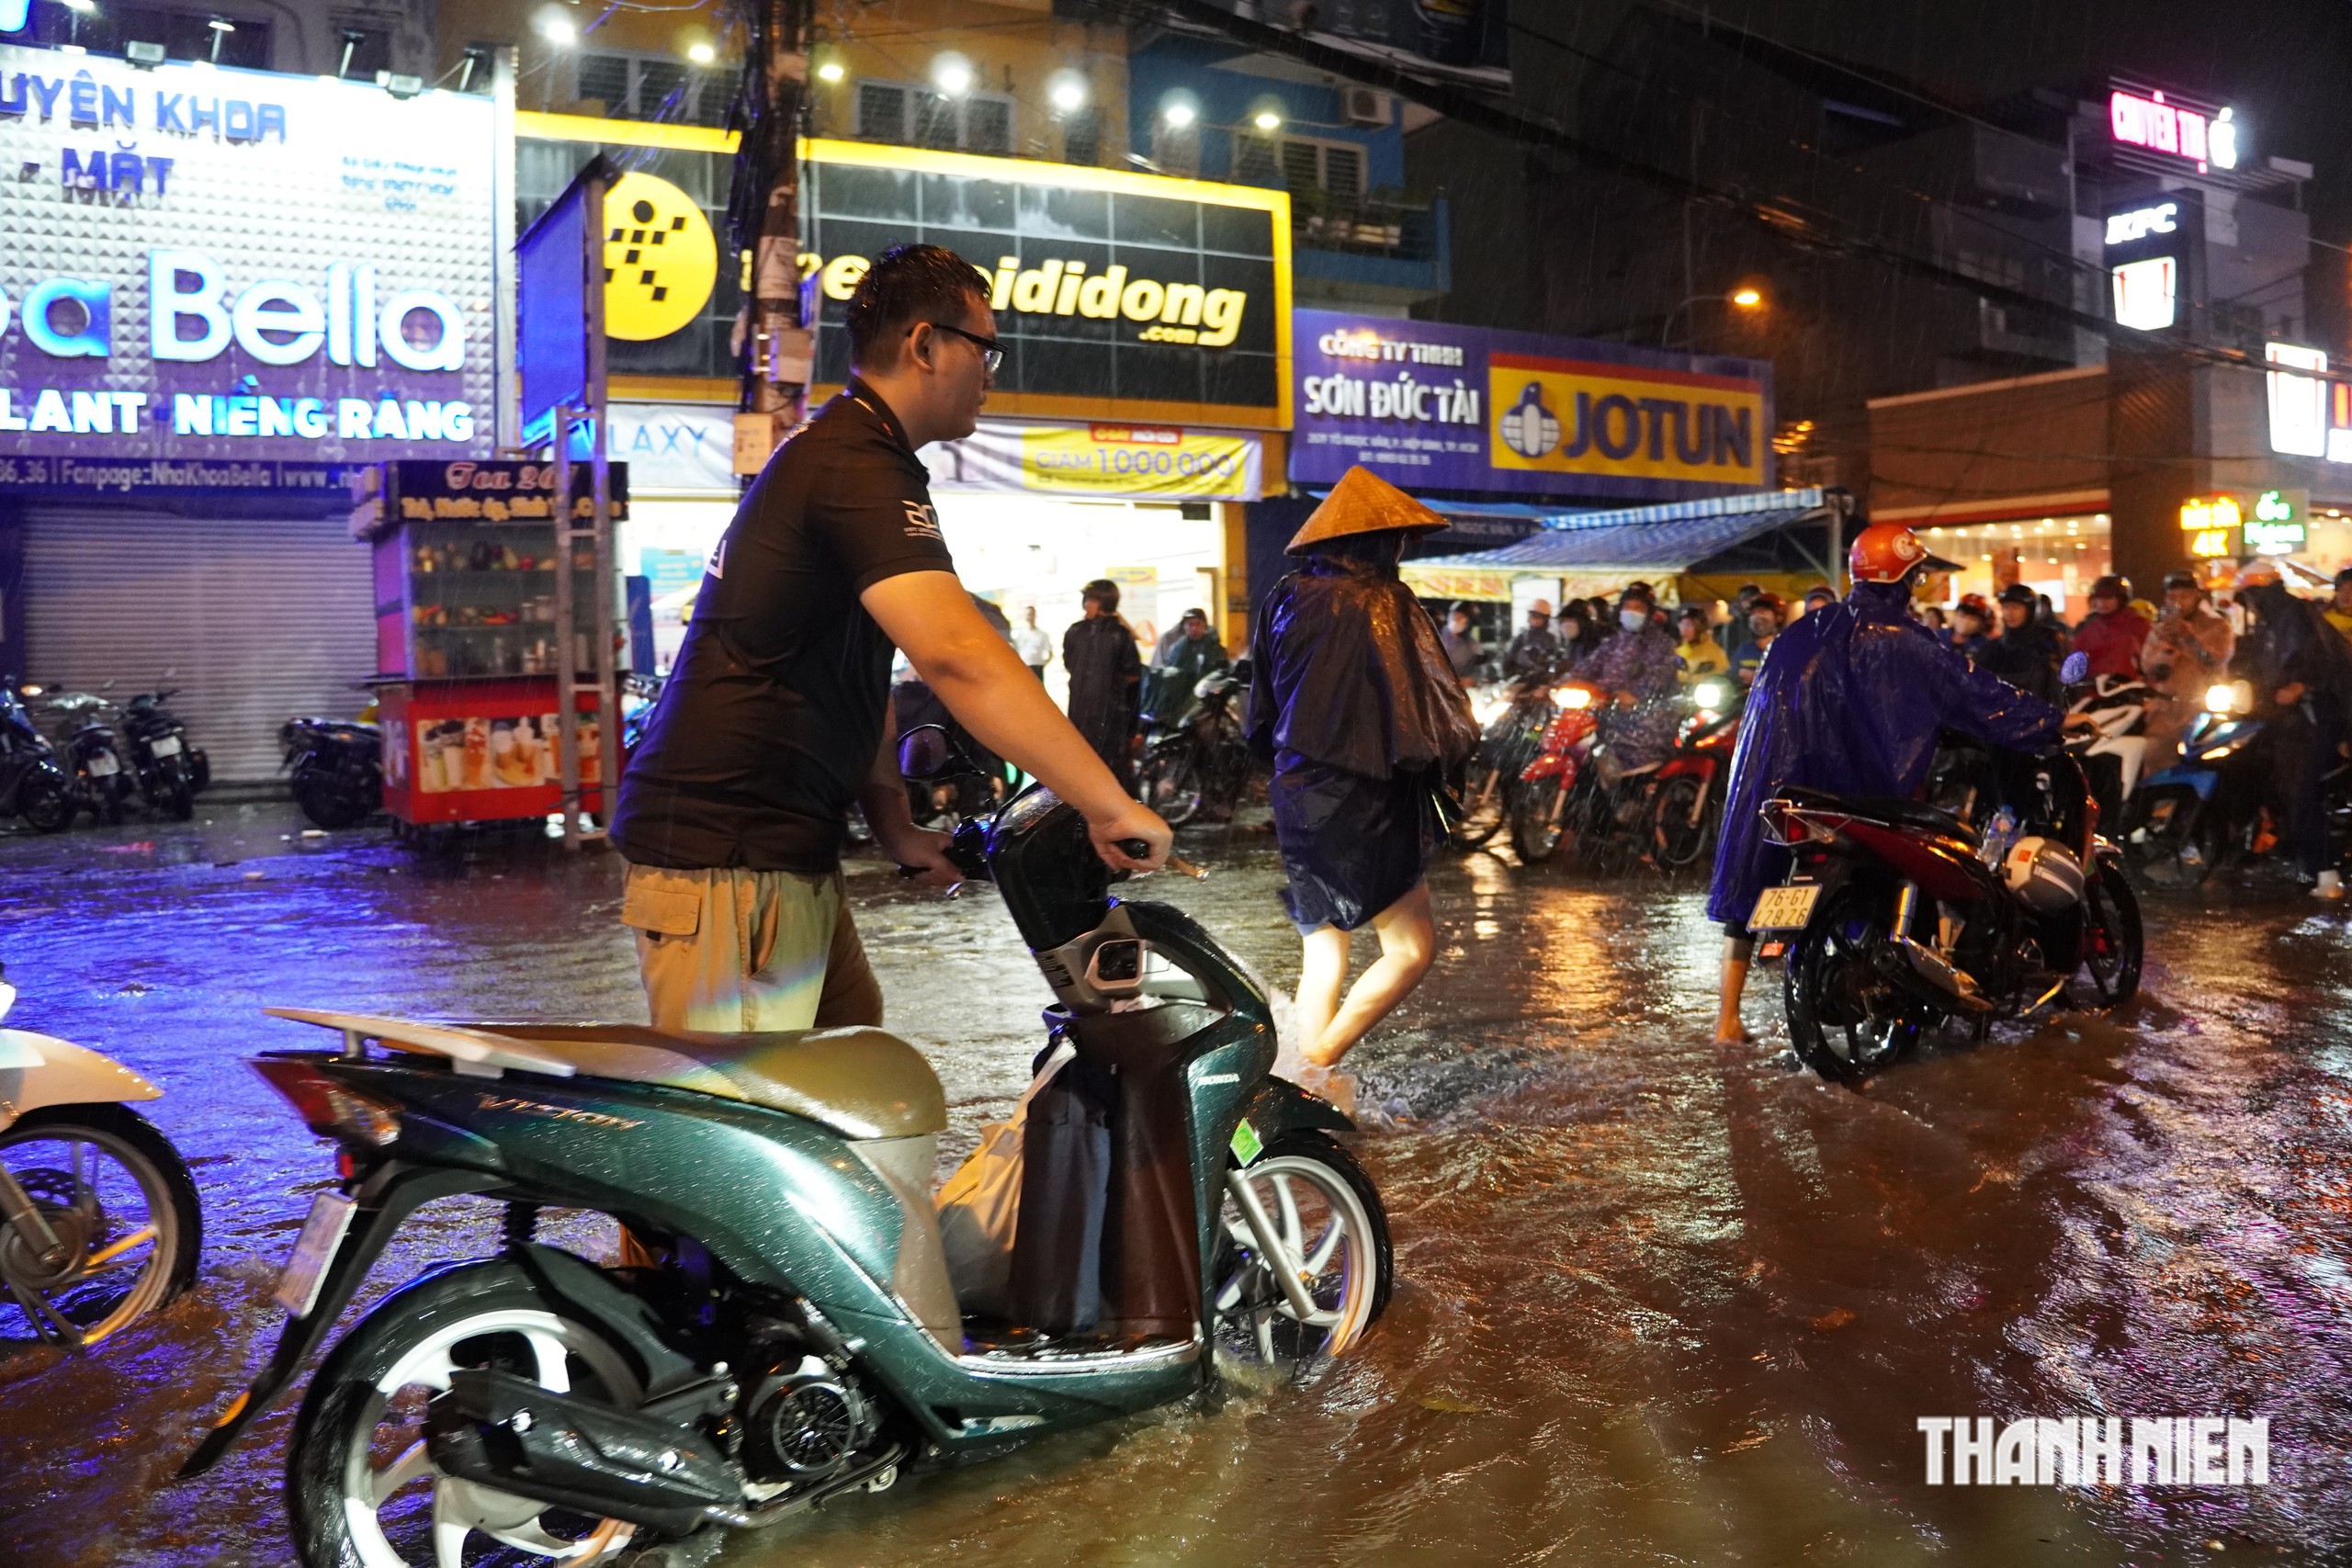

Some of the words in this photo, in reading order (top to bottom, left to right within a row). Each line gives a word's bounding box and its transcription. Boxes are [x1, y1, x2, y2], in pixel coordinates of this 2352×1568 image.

[156, 90, 286, 141] KHOA
[2104, 203, 2177, 244] KFC
[150, 248, 466, 371] Bella
[1137, 324, 1198, 345] .com
[1318, 329, 1380, 360] CÔNG
[1381, 340, 1408, 362] TY
[338, 390, 474, 442] RĂNG
[1303, 372, 1366, 417] SƠN
[1369, 370, 1432, 422] ĐỨC
[1433, 378, 1480, 424] TÀI
[1564, 390, 1752, 468] JOTUN
[1765, 888, 1809, 908] 76-G1
